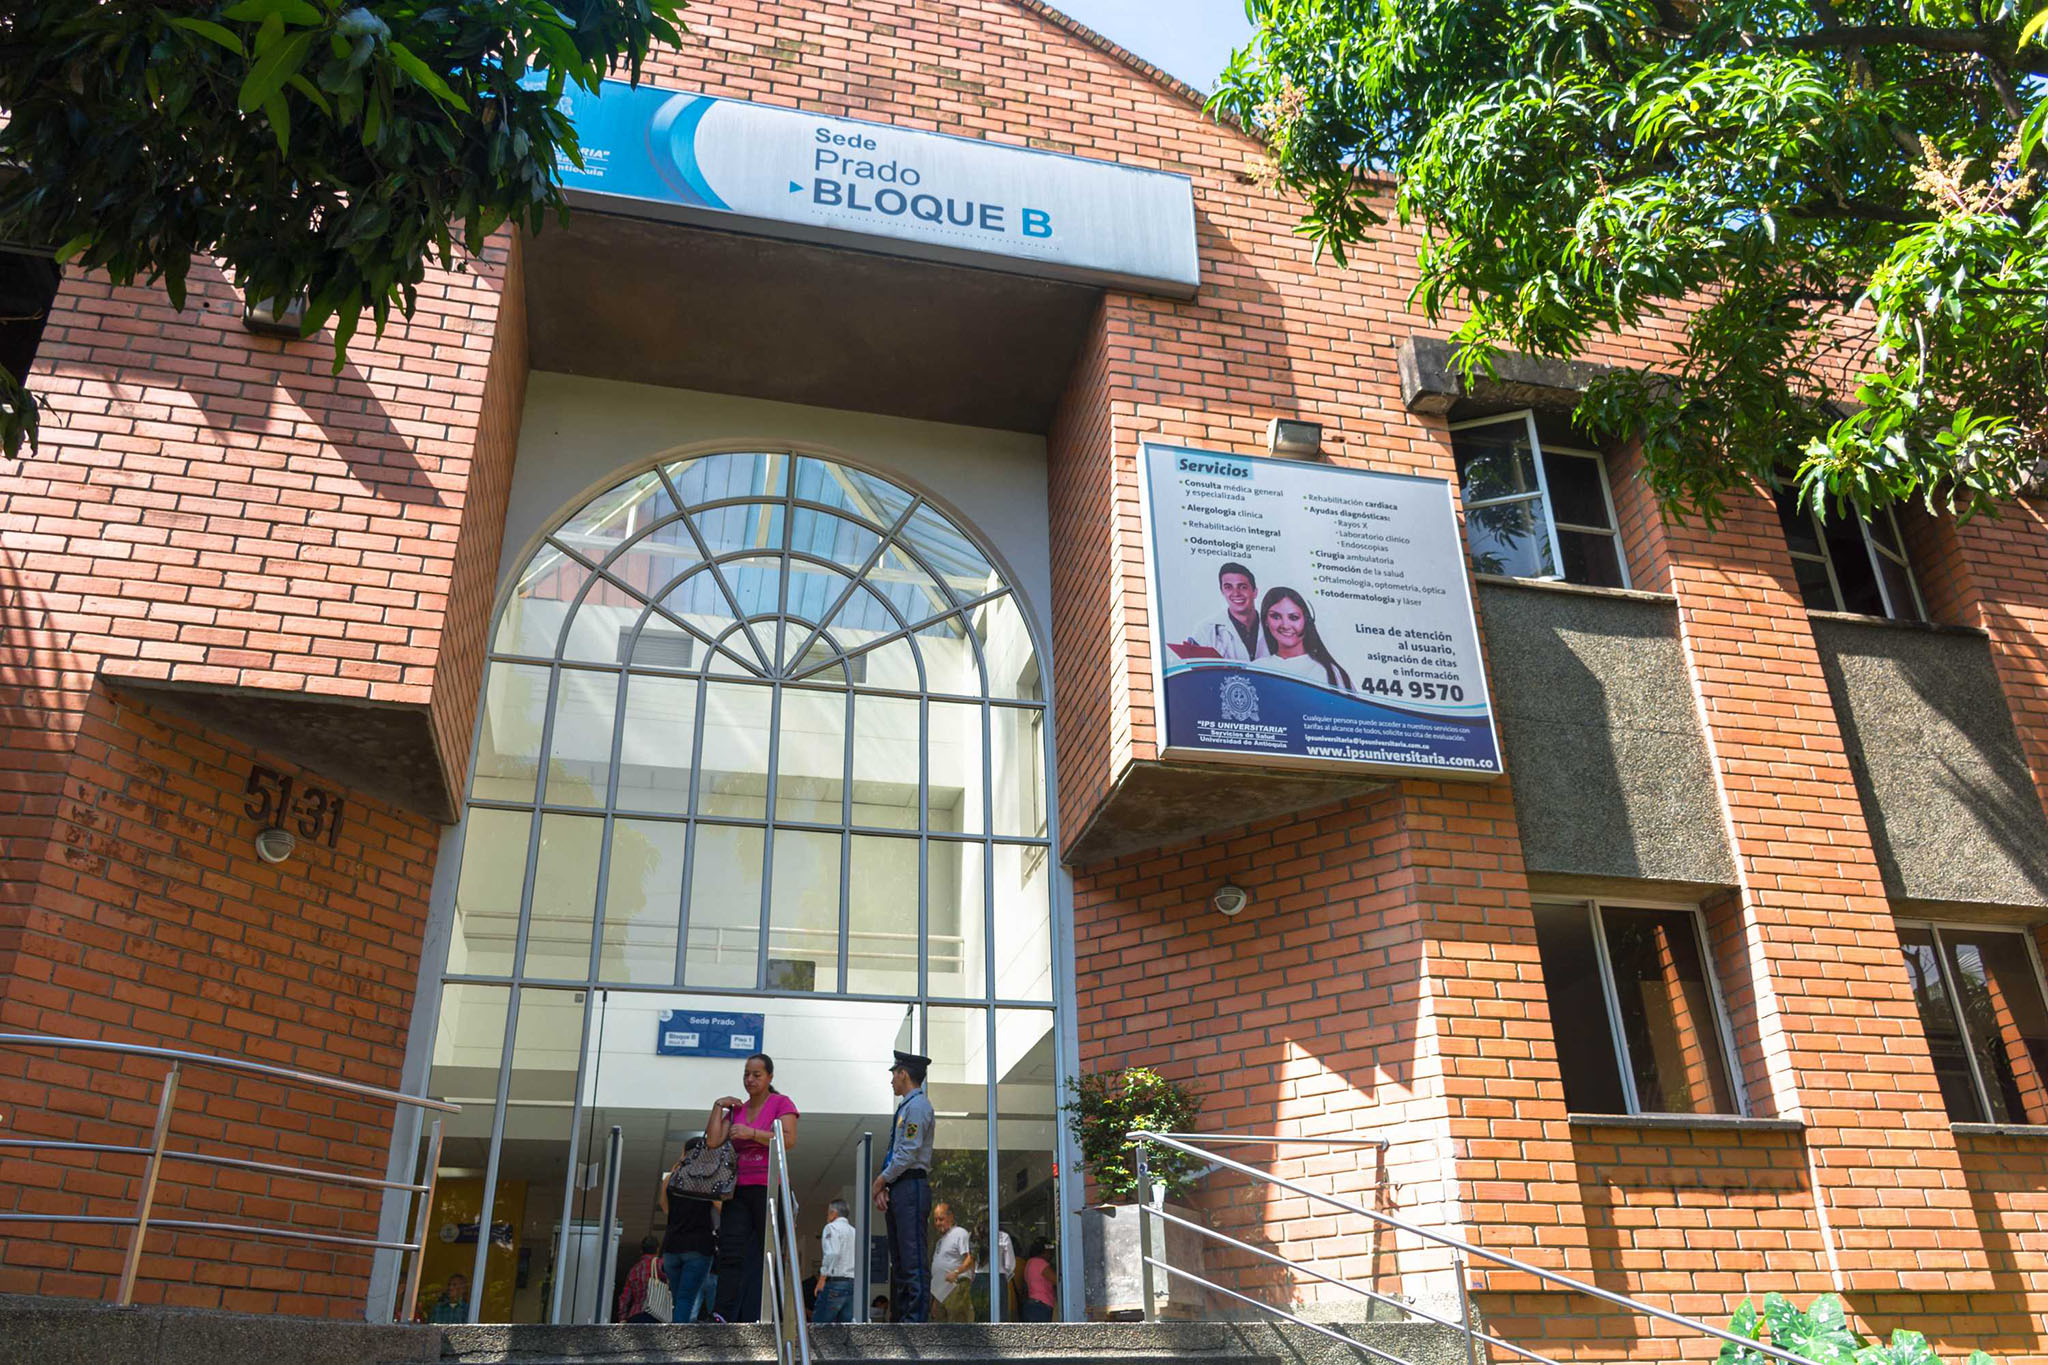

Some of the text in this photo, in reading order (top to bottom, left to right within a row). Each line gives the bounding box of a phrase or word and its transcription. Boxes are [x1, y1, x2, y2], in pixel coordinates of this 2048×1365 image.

[816, 128, 876, 150] Sede
[815, 148, 920, 186] Prado
[813, 178, 1053, 238] BLOQUE B
[1180, 458, 1248, 478] Servicios
[1184, 479, 1283, 496] Consulta médica general
[1192, 490, 1245, 501] especializada
[1308, 494, 1363, 506] Rehabilitación
[1310, 506, 1338, 516] Ayudas
[1188, 520, 1281, 538] Rehabilitación integral
[1338, 520, 1360, 529] Rayos
[1339, 530, 1384, 541] Laboratorio
[1198, 547, 1252, 559] especializada
[1246, 544, 1275, 552] general
[1346, 554, 1394, 565] ambulatoria
[1317, 562, 1404, 578] Promoción de la salud
[1422, 585, 1446, 595] óptica
[1396, 598, 1402, 606] y
[1355, 624, 1452, 642] Línea de atención
[1398, 641, 1456, 656] al usuario,
[1368, 652, 1457, 668] asignación de citas
[1401, 667, 1459, 681] información
[1362, 677, 1464, 702] 444 9570
[1302, 714, 1332, 723] Cualquier
[1211, 730, 1243, 738] Servicios
[1200, 736, 1242, 745] Universidad
[1254, 740, 1287, 748] Antioquia
[1307, 745, 1493, 768] www.ipsuniversitaria.com.co
[690, 1016, 735, 1026] Sede Prado
